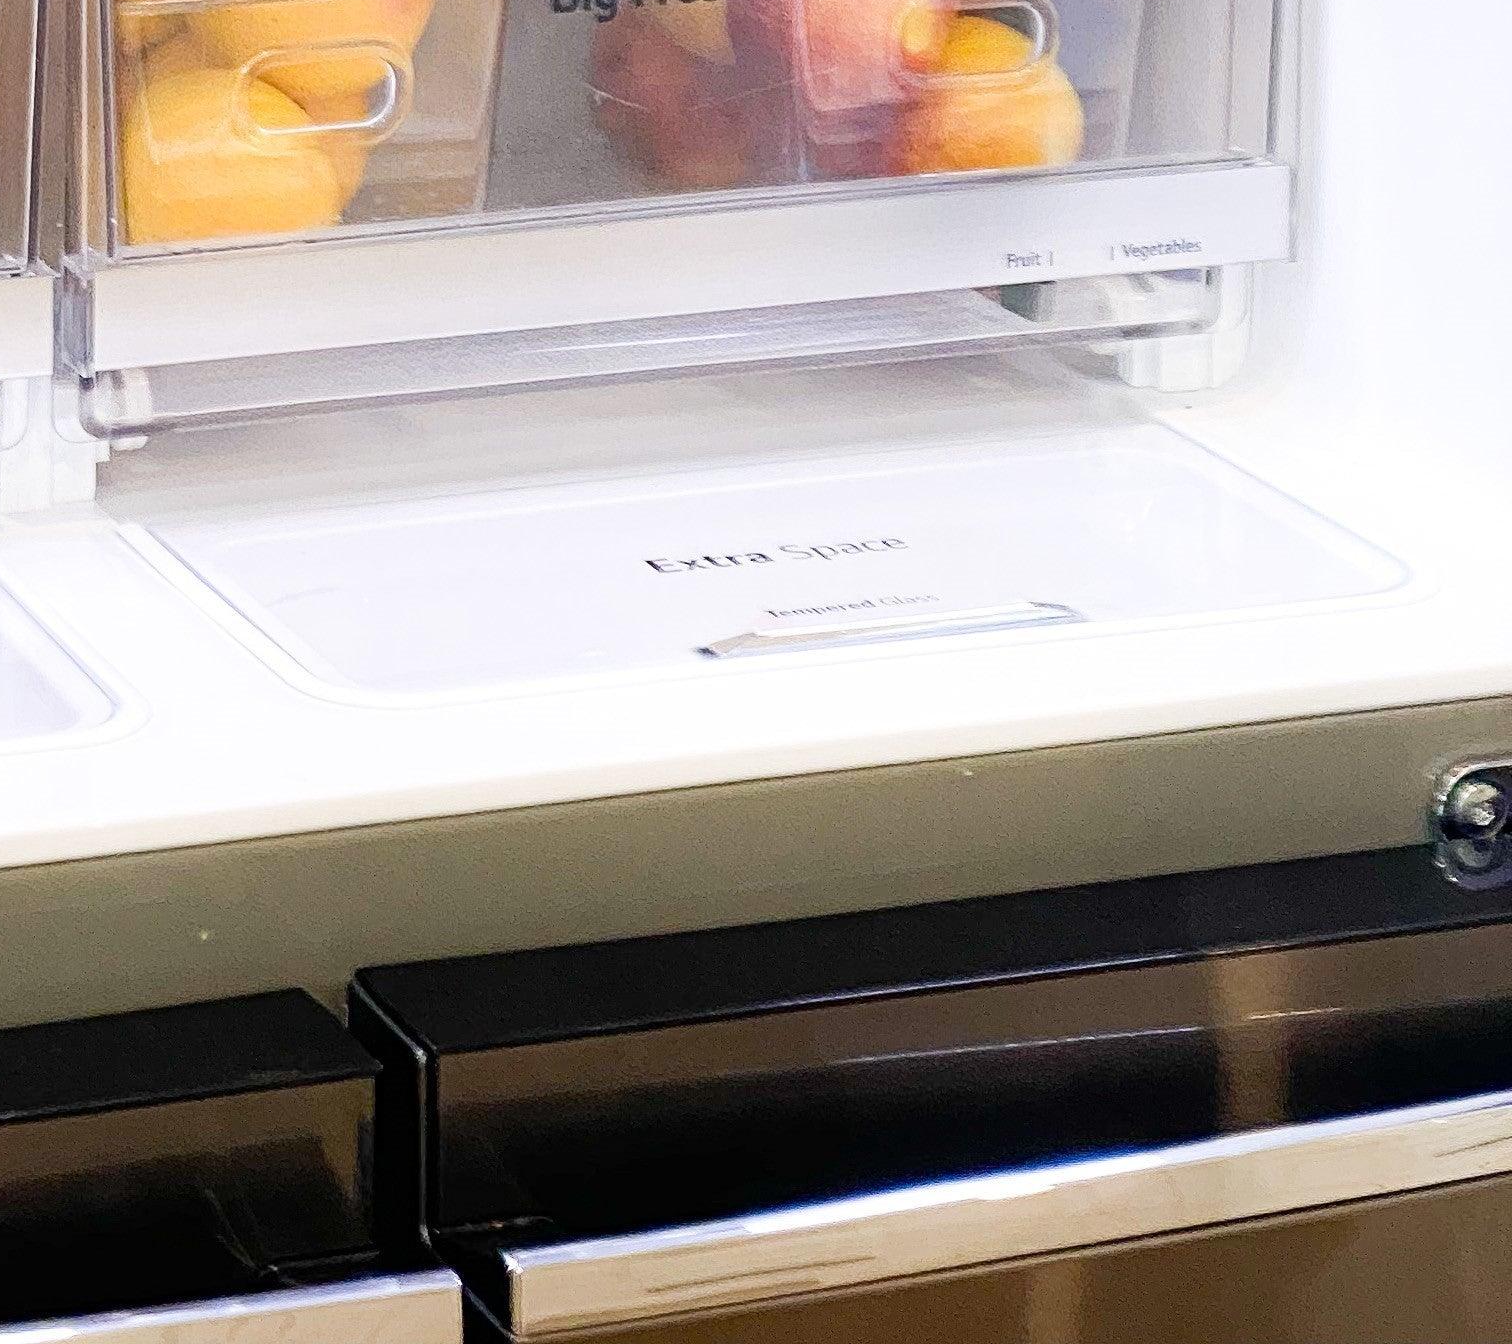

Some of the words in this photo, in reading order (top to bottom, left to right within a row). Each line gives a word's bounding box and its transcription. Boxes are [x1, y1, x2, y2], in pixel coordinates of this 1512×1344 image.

[1006, 251, 1043, 269] Fruit
[1121, 238, 1203, 261] Vegetables
[643, 550, 775, 574] Extra
[778, 536, 908, 561] Space
[764, 598, 877, 618] Tempered
[879, 593, 941, 606] Glass
